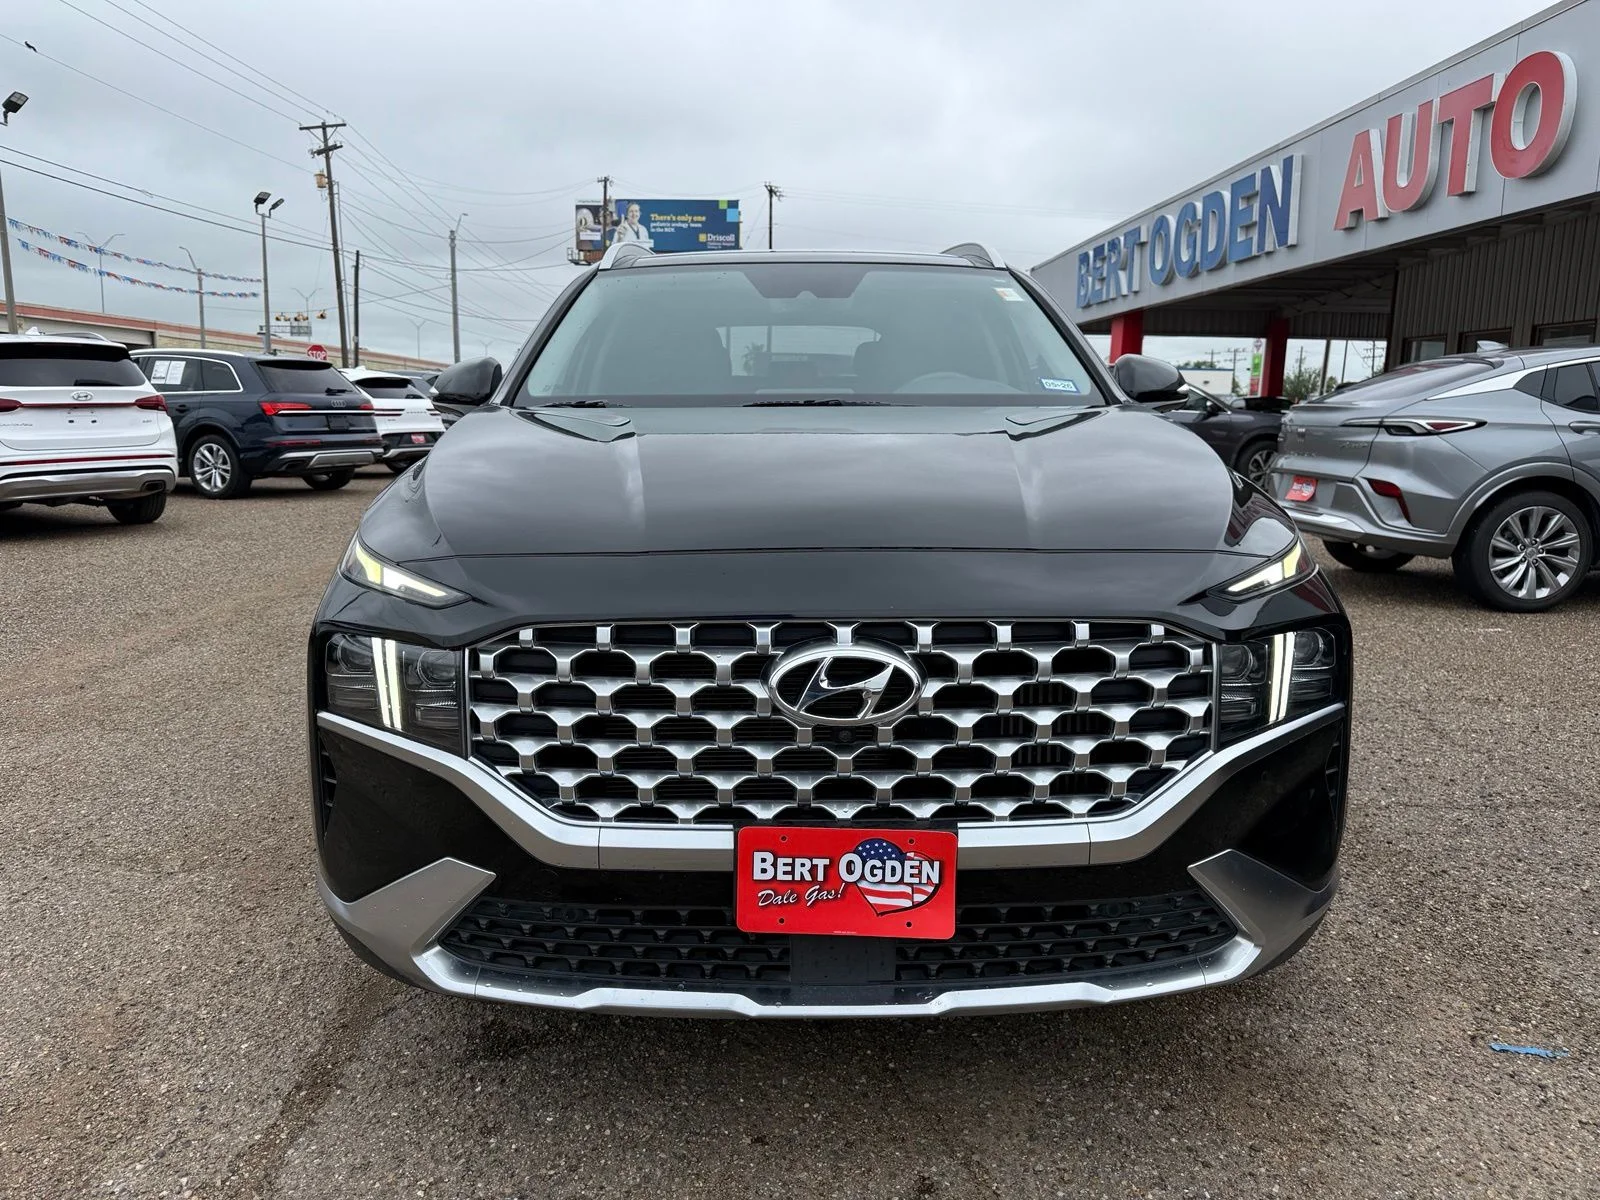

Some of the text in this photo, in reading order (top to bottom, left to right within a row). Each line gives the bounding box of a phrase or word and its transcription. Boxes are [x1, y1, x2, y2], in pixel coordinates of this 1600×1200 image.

[1076, 50, 1578, 309] BERT OGDEN AUTO
[676, 214, 692, 223] only
[707, 233, 735, 241] Driscoll
[308, 350, 326, 359] STOP
[752, 850, 941, 884] BERT OGDEN
[757, 882, 845, 907] Dale Gas!
